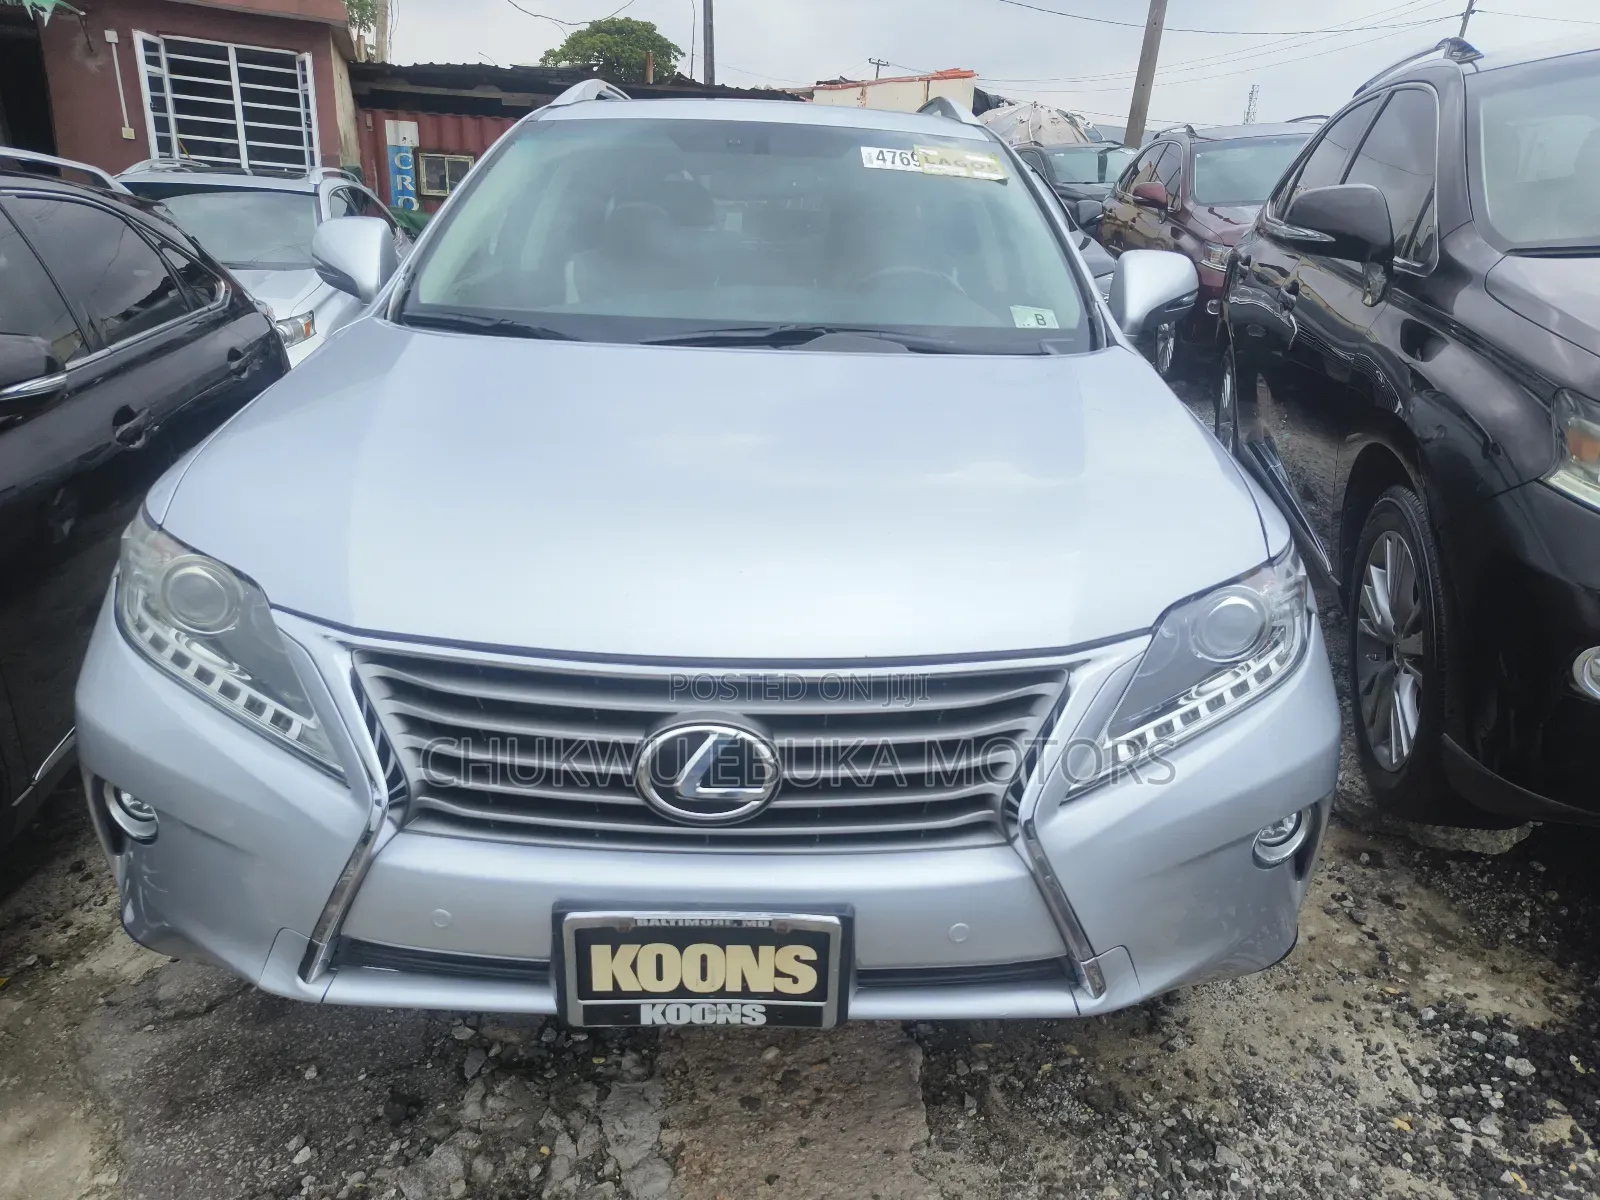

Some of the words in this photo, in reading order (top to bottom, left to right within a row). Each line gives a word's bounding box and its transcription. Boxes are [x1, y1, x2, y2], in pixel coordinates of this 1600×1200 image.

[1034, 313, 1047, 326] B
[743, 919, 771, 928] MD
[590, 943, 818, 994] KOONS
[640, 1003, 767, 1026] KOONS
